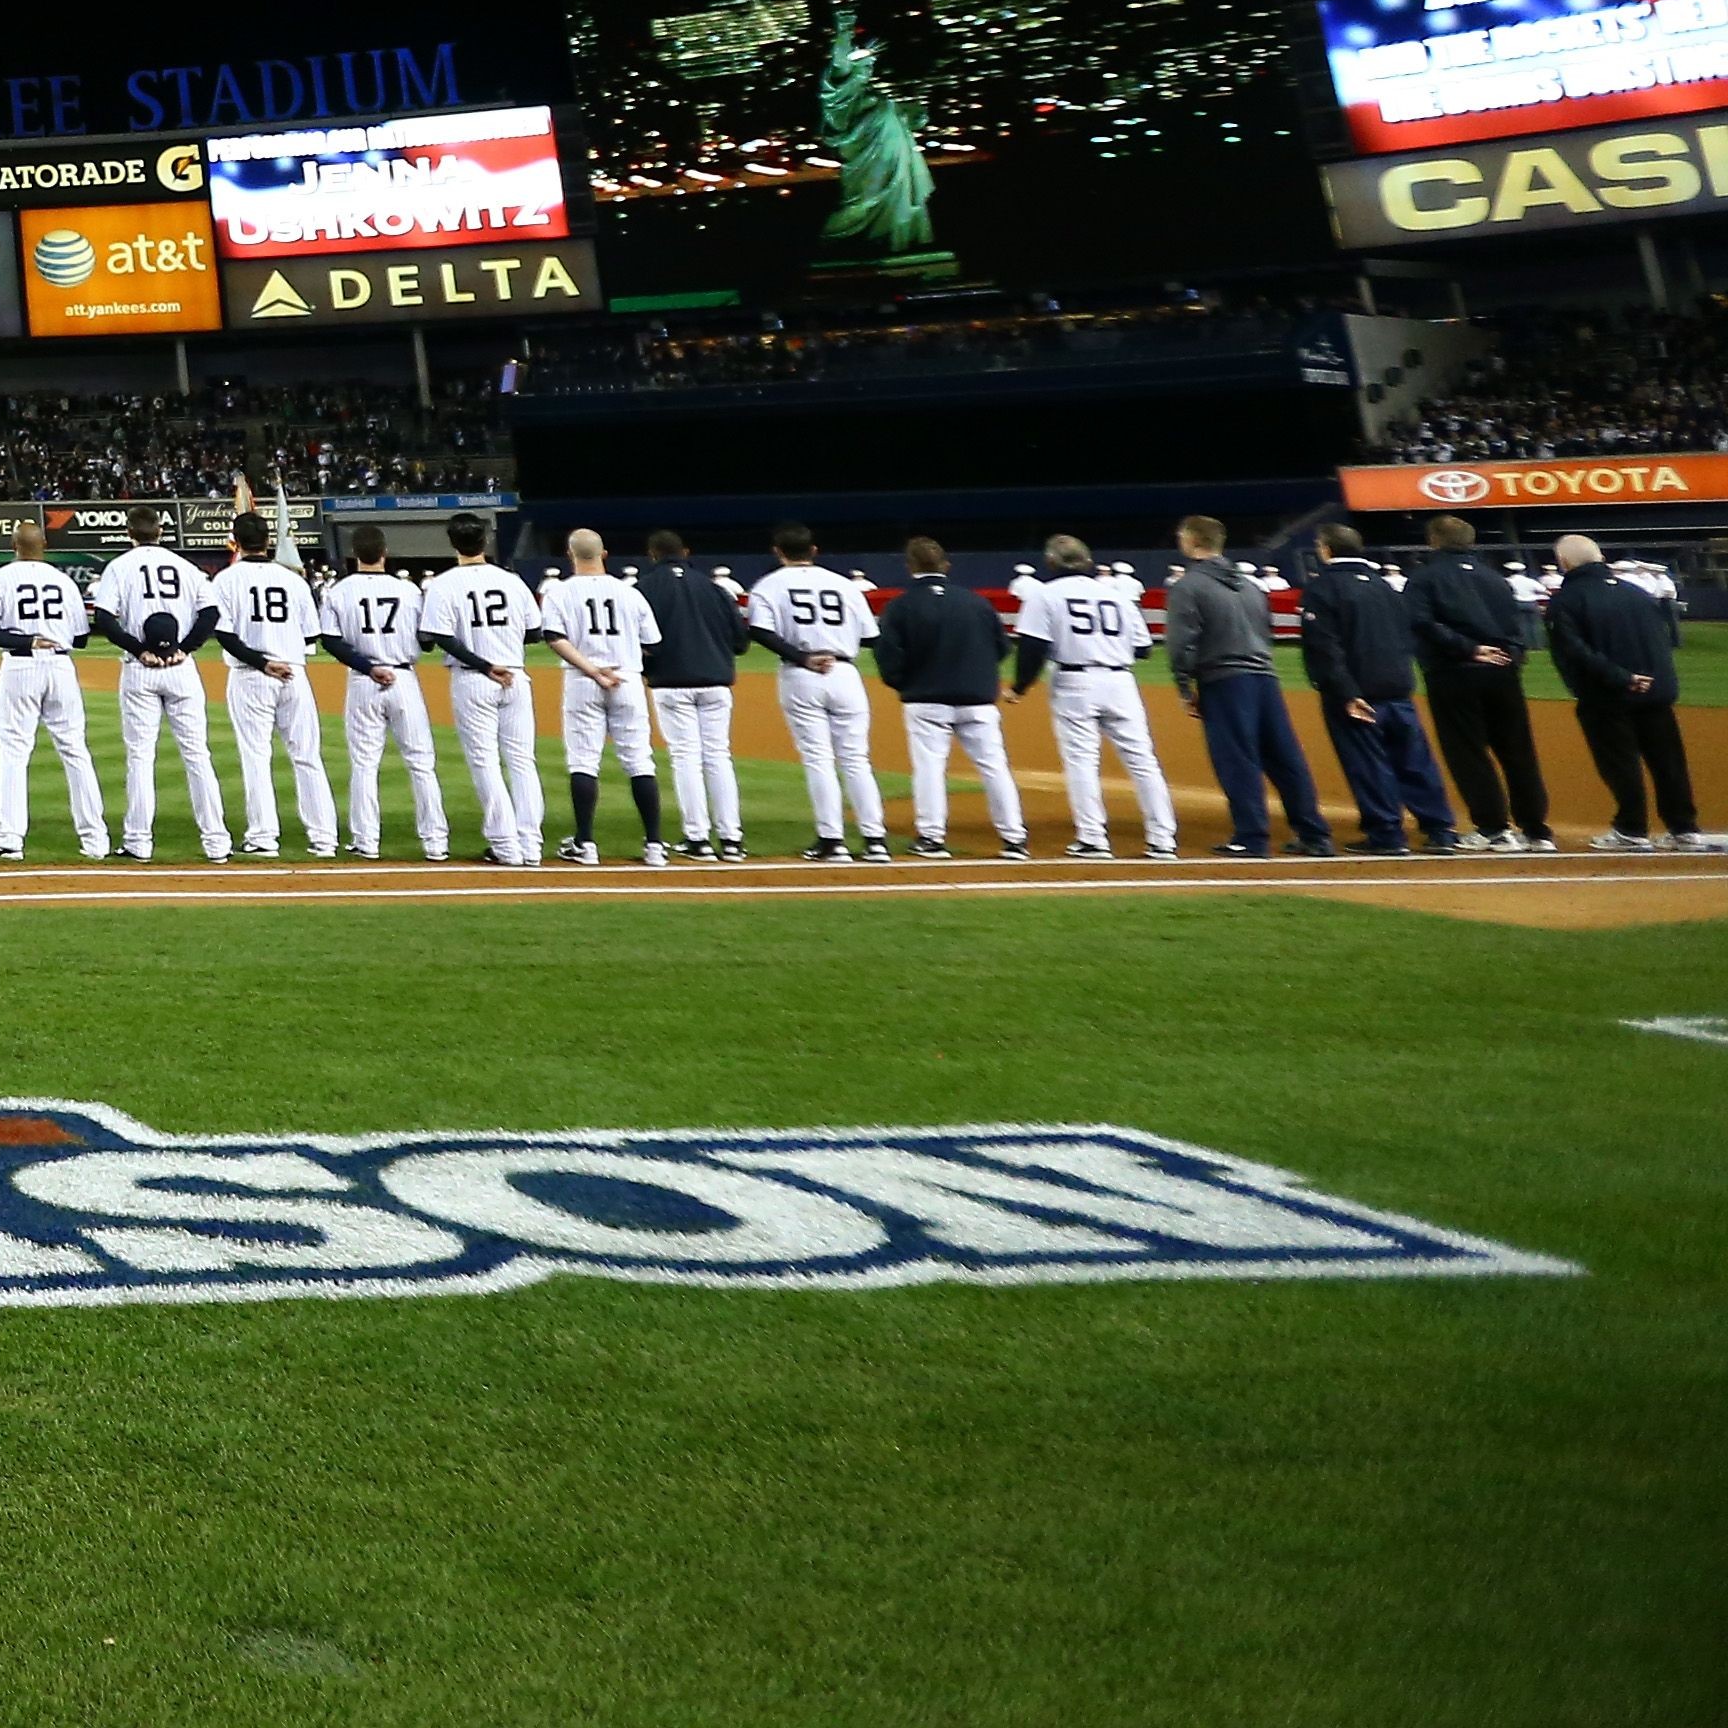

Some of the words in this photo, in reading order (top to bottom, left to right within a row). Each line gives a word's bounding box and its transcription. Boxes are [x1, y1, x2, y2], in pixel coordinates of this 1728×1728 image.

[127, 42, 463, 131] STADIUM
[289, 155, 469, 195] JENNA
[228, 202, 549, 245] USHKOWITZ
[107, 232, 206, 274] at&t
[329, 257, 580, 310] DELTA
[65, 302, 181, 319] att.yankees.com
[1493, 466, 1689, 497] TOYOTA
[140, 565, 180, 599] 19
[17, 585, 62, 620] 22
[250, 587, 288, 622] 18
[359, 598, 399, 634] 17
[467, 590, 507, 627] 12
[586, 599, 619, 635] 11
[789, 589, 843, 626] 59
[1067, 599, 1120, 636] 50
